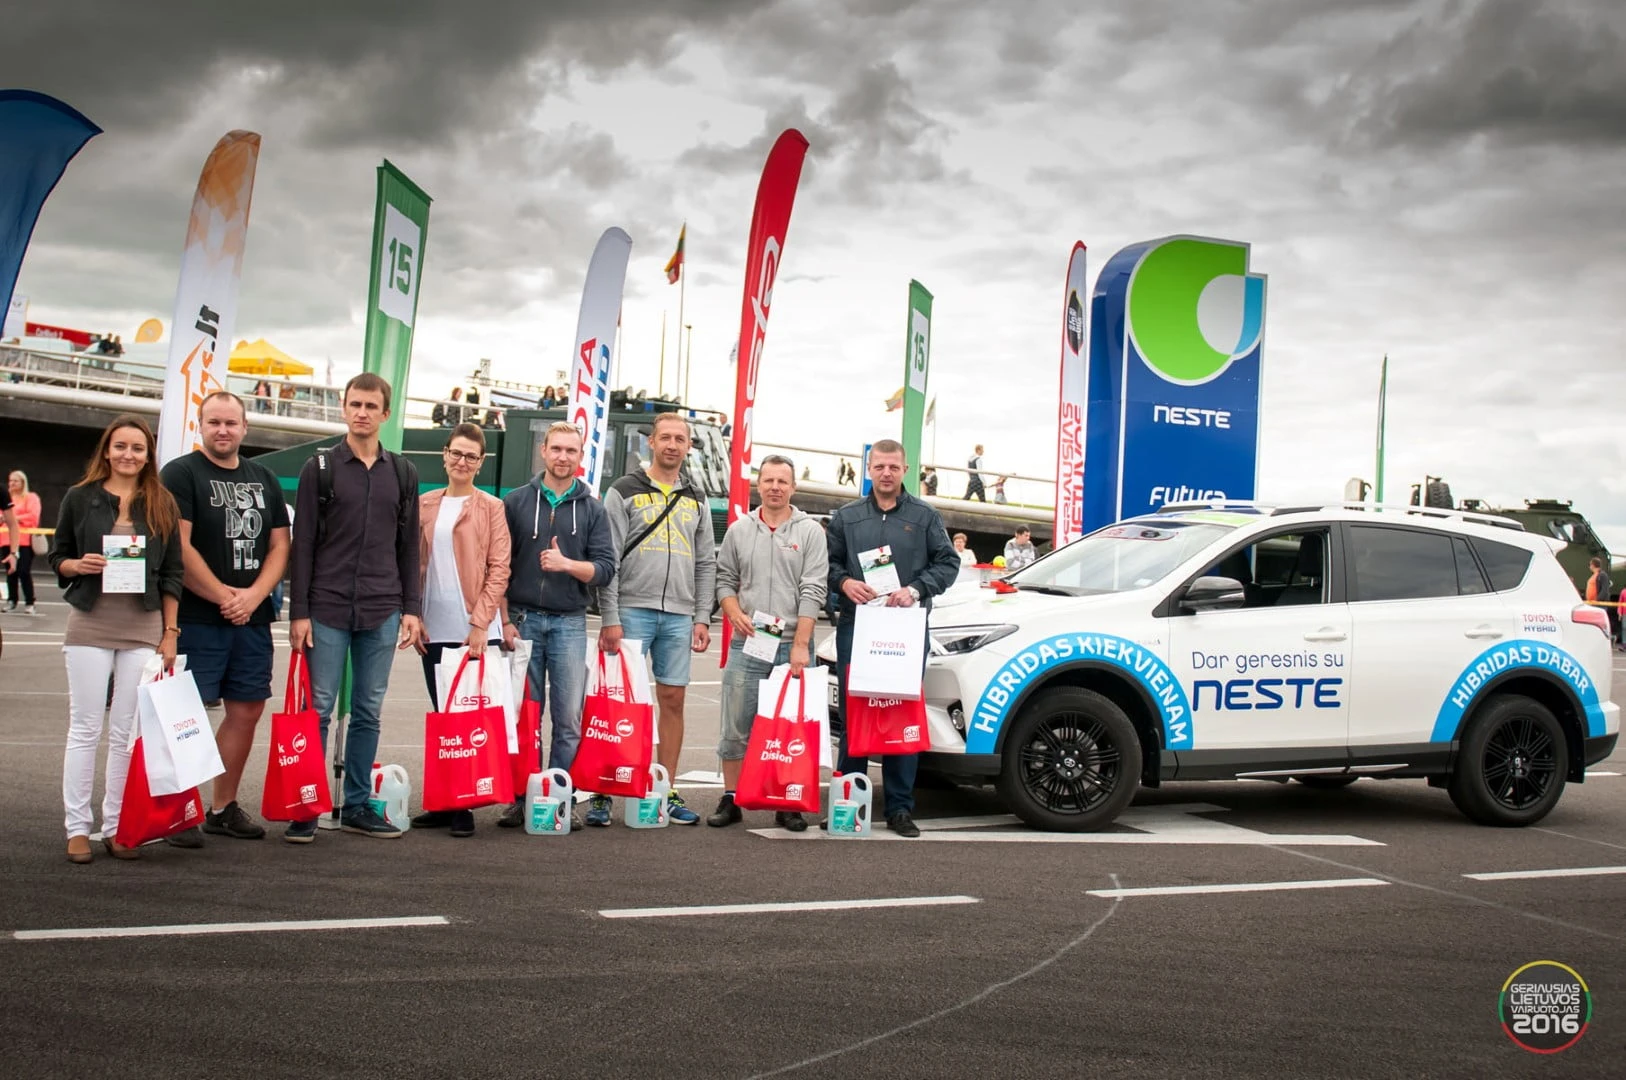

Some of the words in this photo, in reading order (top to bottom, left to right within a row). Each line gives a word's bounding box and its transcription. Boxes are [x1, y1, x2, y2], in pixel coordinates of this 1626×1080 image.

[388, 237, 413, 295] 15
[914, 332, 925, 372] 15
[1153, 405, 1231, 429] NESTE
[210, 480, 266, 509] JUST
[225, 508, 263, 539] DO
[232, 539, 260, 570] IT.
[1522, 614, 1555, 623] TOYOTA
[1524, 625, 1557, 633] HYBRID
[871, 640, 906, 649] TOYOTA
[1192, 651, 1229, 669] Dar
[1235, 650, 1318, 674] geresnis
[1323, 653, 1344, 667] su
[974, 638, 1074, 734] HIBRIDAS
[1076, 636, 1188, 743] KIEKVIENAM
[1452, 646, 1532, 709] HIBRIDAS
[1536, 647, 1589, 695] DABAR
[1192, 678, 1343, 712] NESTE
[173, 718, 198, 732] TOYOTA
[438, 748, 477, 760] Division
